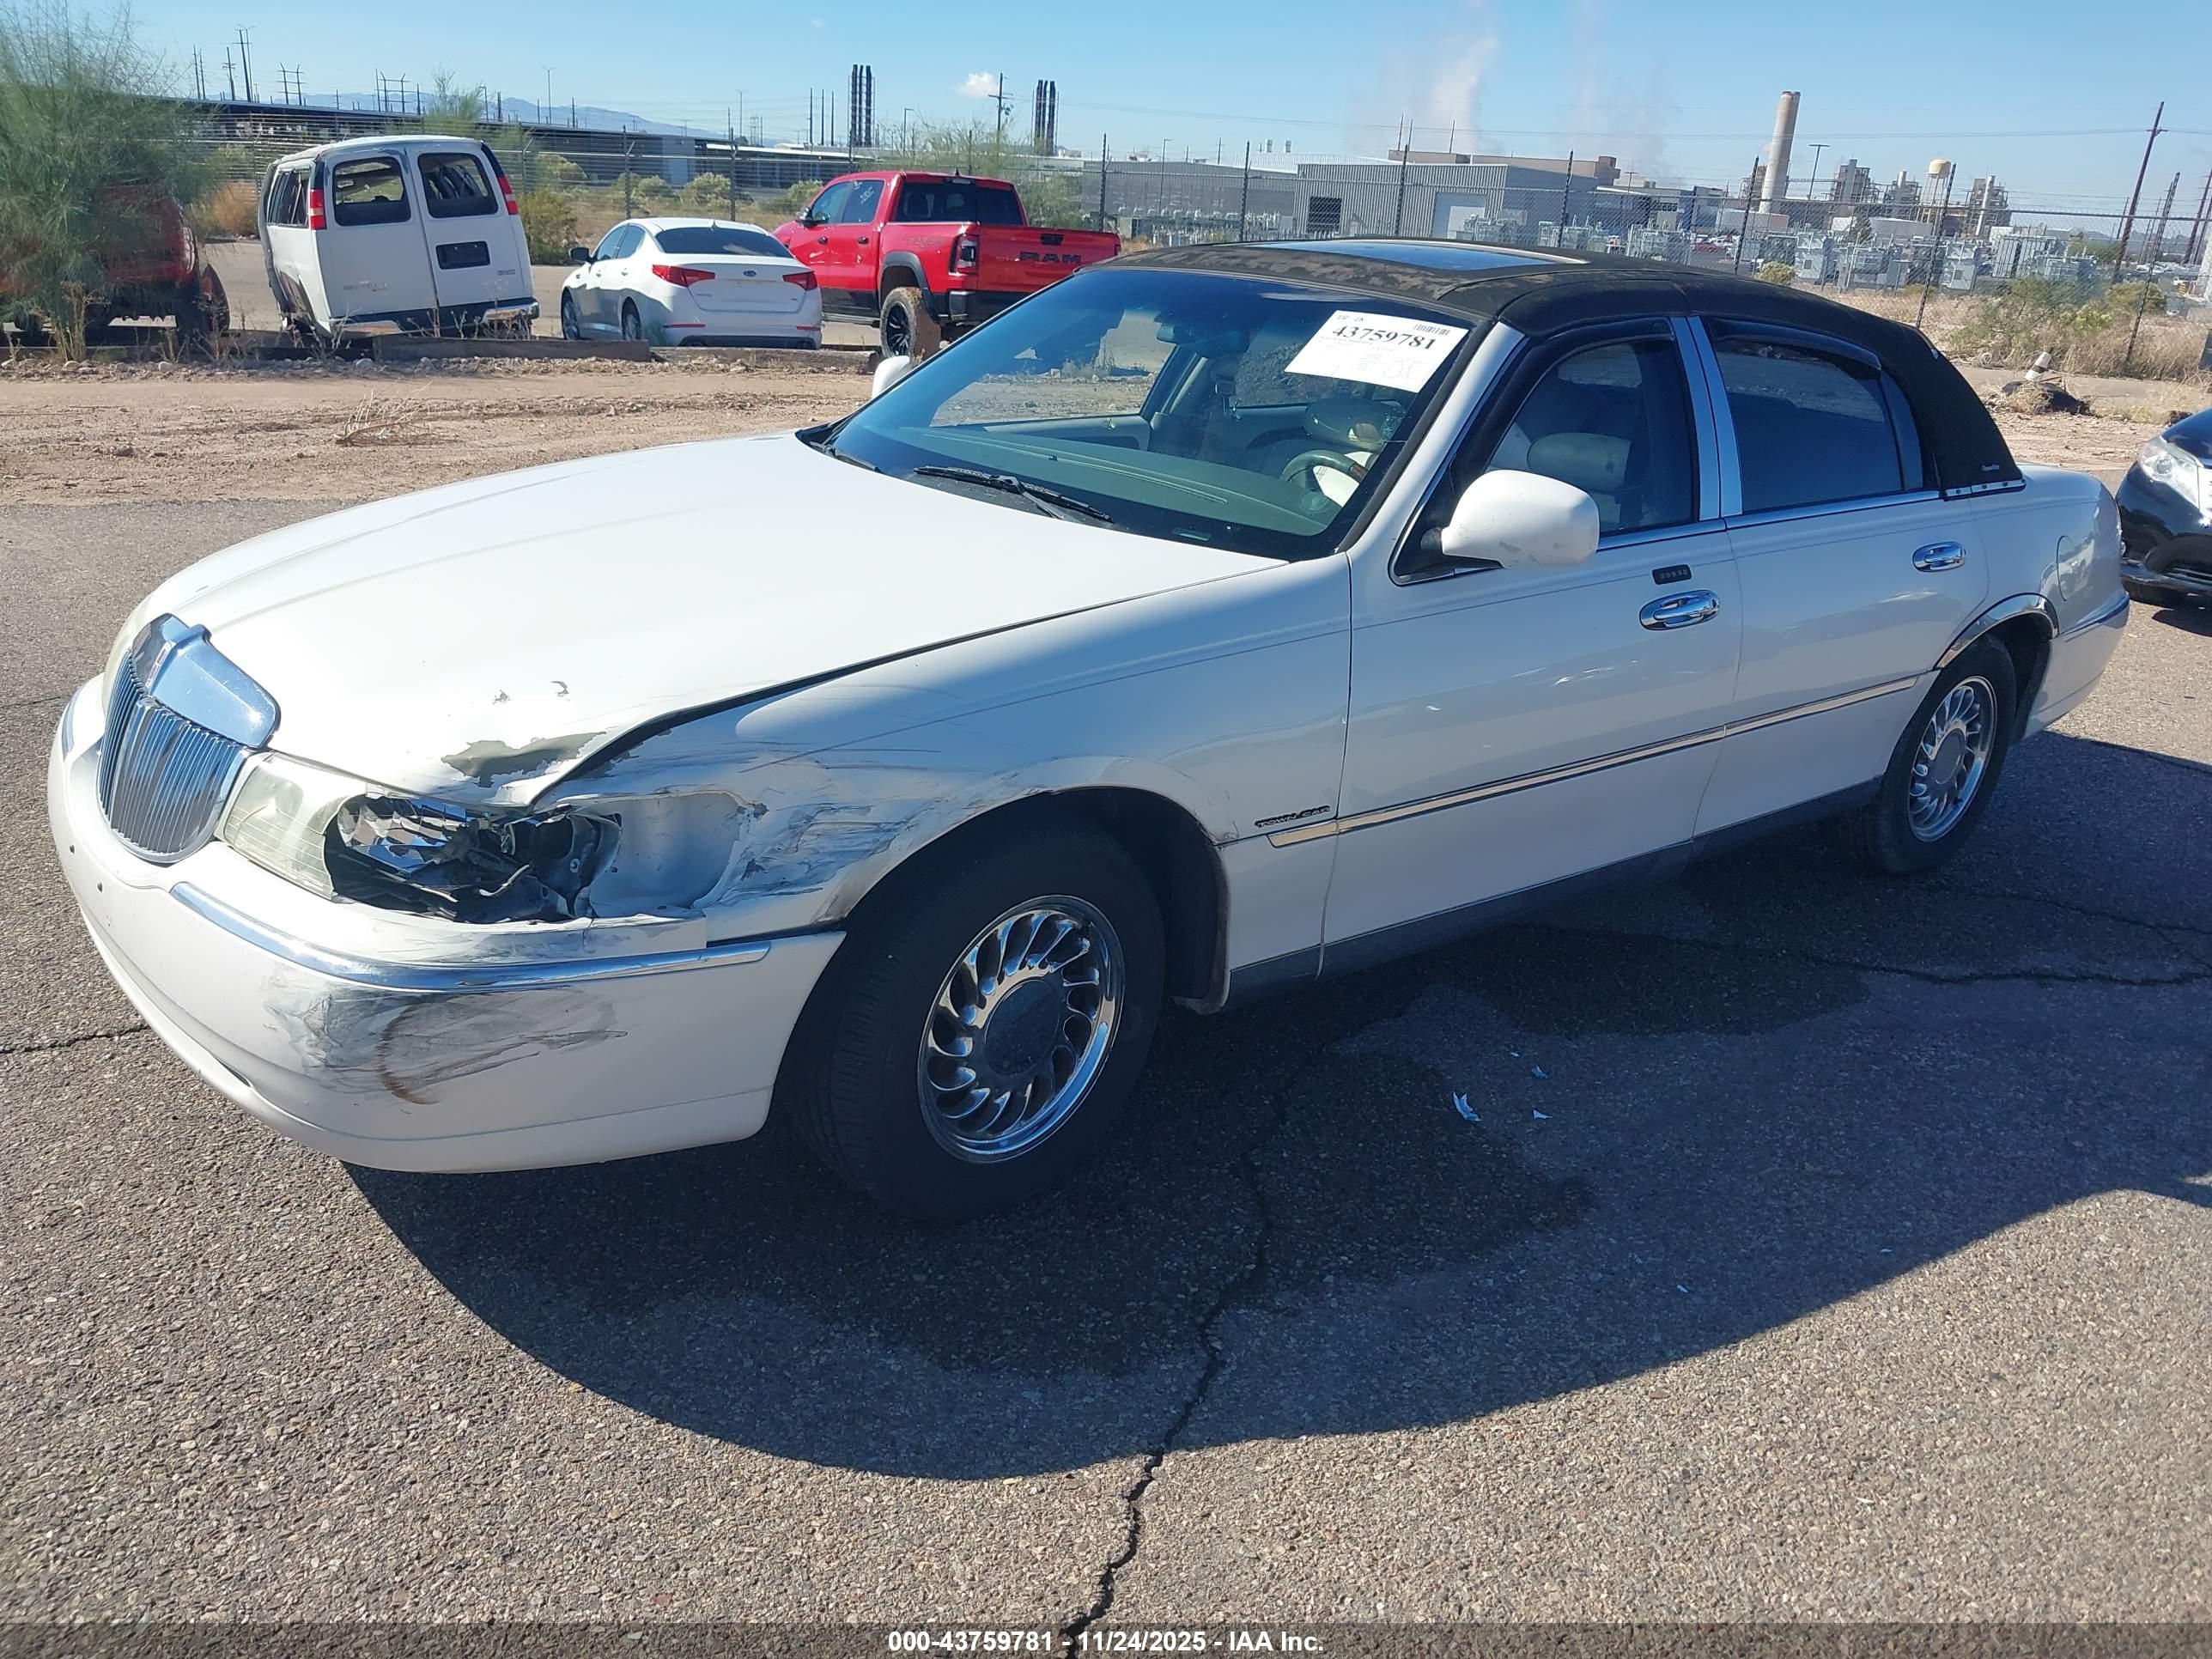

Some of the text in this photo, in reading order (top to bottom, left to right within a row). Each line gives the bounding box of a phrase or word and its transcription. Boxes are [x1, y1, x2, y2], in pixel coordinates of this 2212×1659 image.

[1020, 252, 1081, 263] RAM
[1333, 325, 1436, 349] 43759781
[1255, 805, 1330, 827] TOWN CAR
